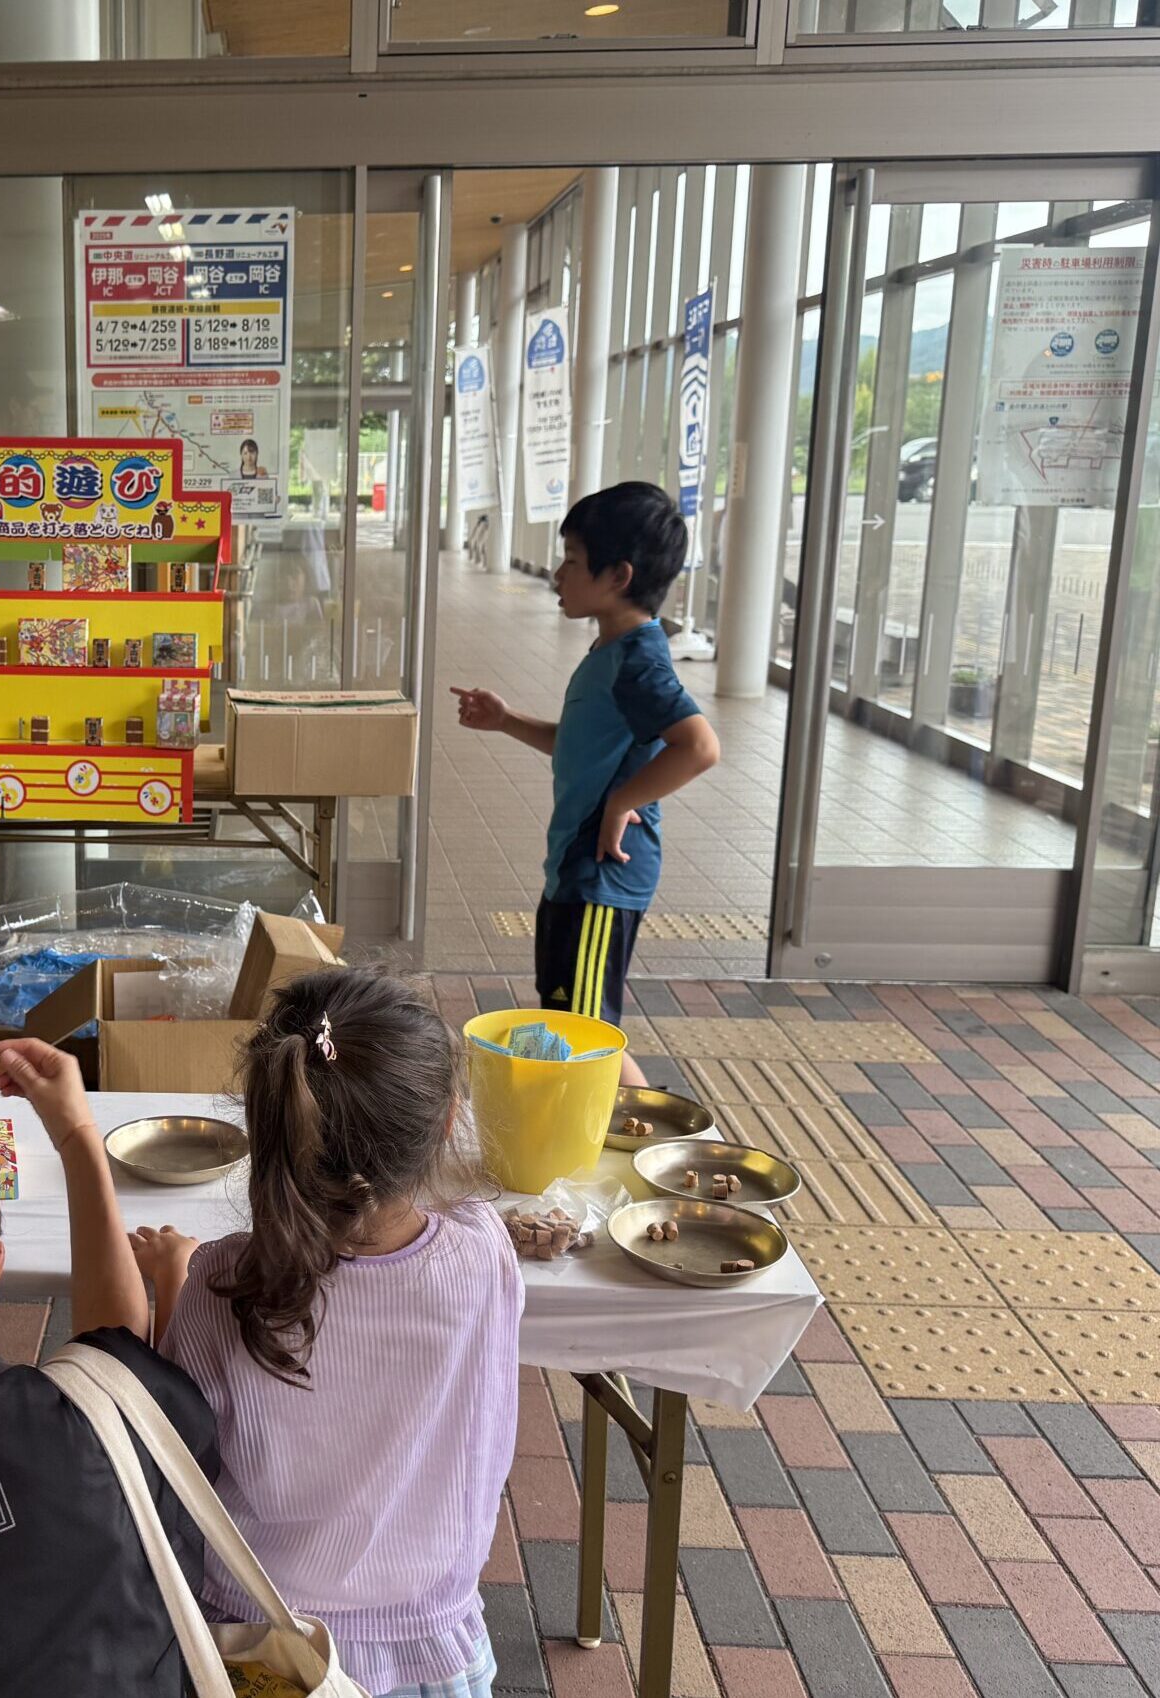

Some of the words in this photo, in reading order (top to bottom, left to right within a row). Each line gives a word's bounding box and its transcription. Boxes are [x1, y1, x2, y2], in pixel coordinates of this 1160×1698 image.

[103, 250, 133, 260] 中央道
[205, 248, 235, 259] 長野道
[92, 267, 123, 285] 伊那
[147, 266, 179, 285] 岡谷
[249, 264, 280, 283] 岡谷
[103, 287, 113, 297] IC
[154, 286, 173, 296] JCT
[259, 284, 269, 294] IC
